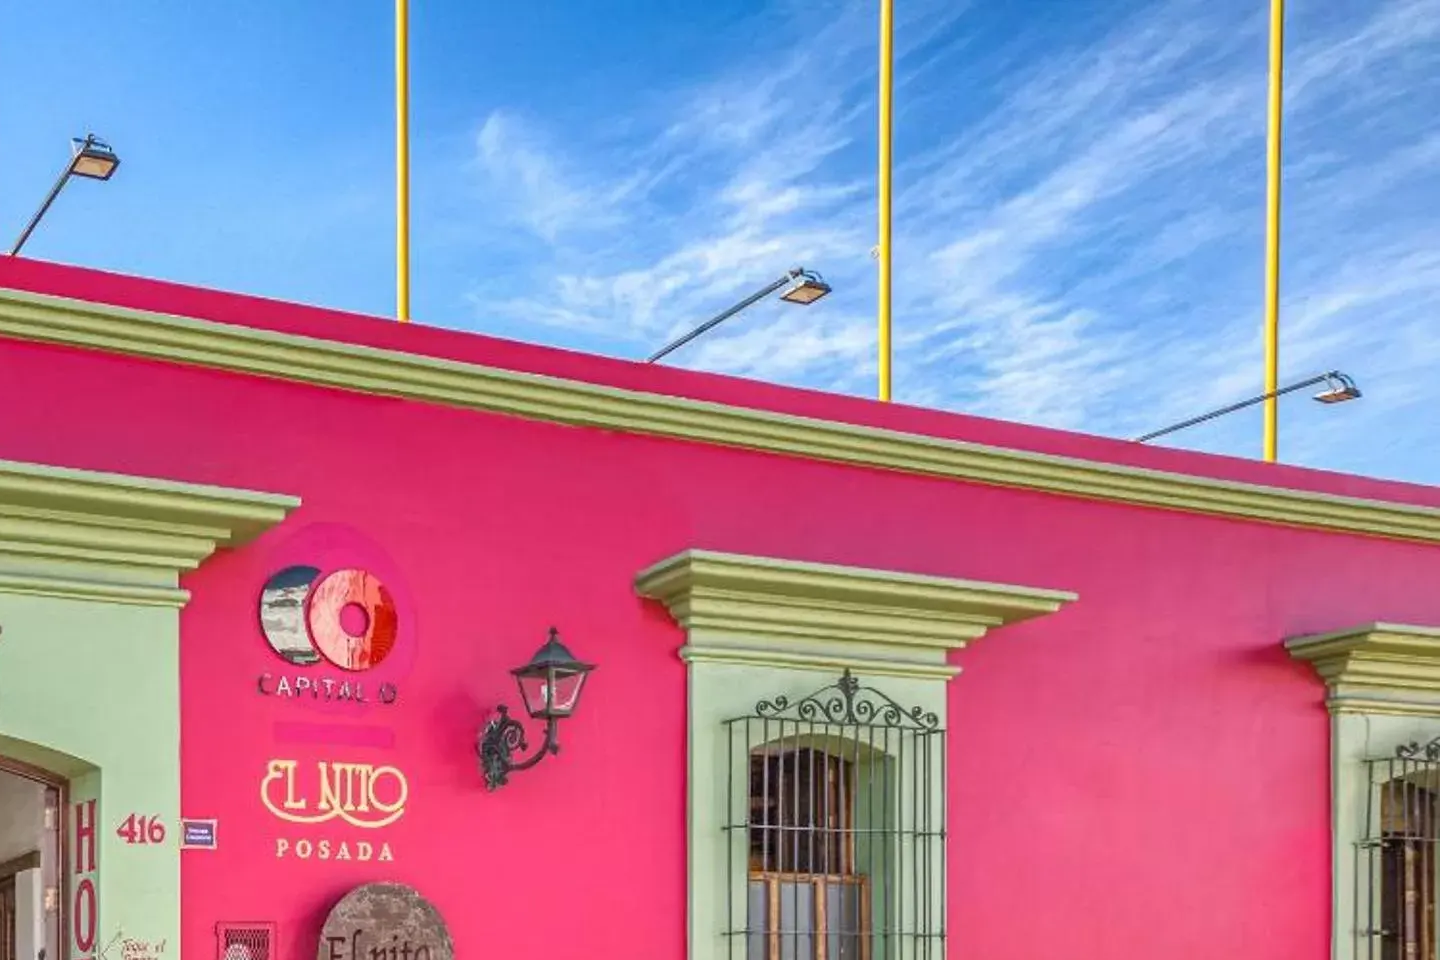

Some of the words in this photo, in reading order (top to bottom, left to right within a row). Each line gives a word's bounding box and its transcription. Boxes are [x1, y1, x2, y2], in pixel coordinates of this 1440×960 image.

[257, 673, 370, 703] CAPITAL
[379, 681, 397, 704] O
[261, 759, 307, 823] EL
[318, 761, 408, 828] NITO
[116, 813, 165, 844] 416
[275, 838, 394, 862] POSADA
